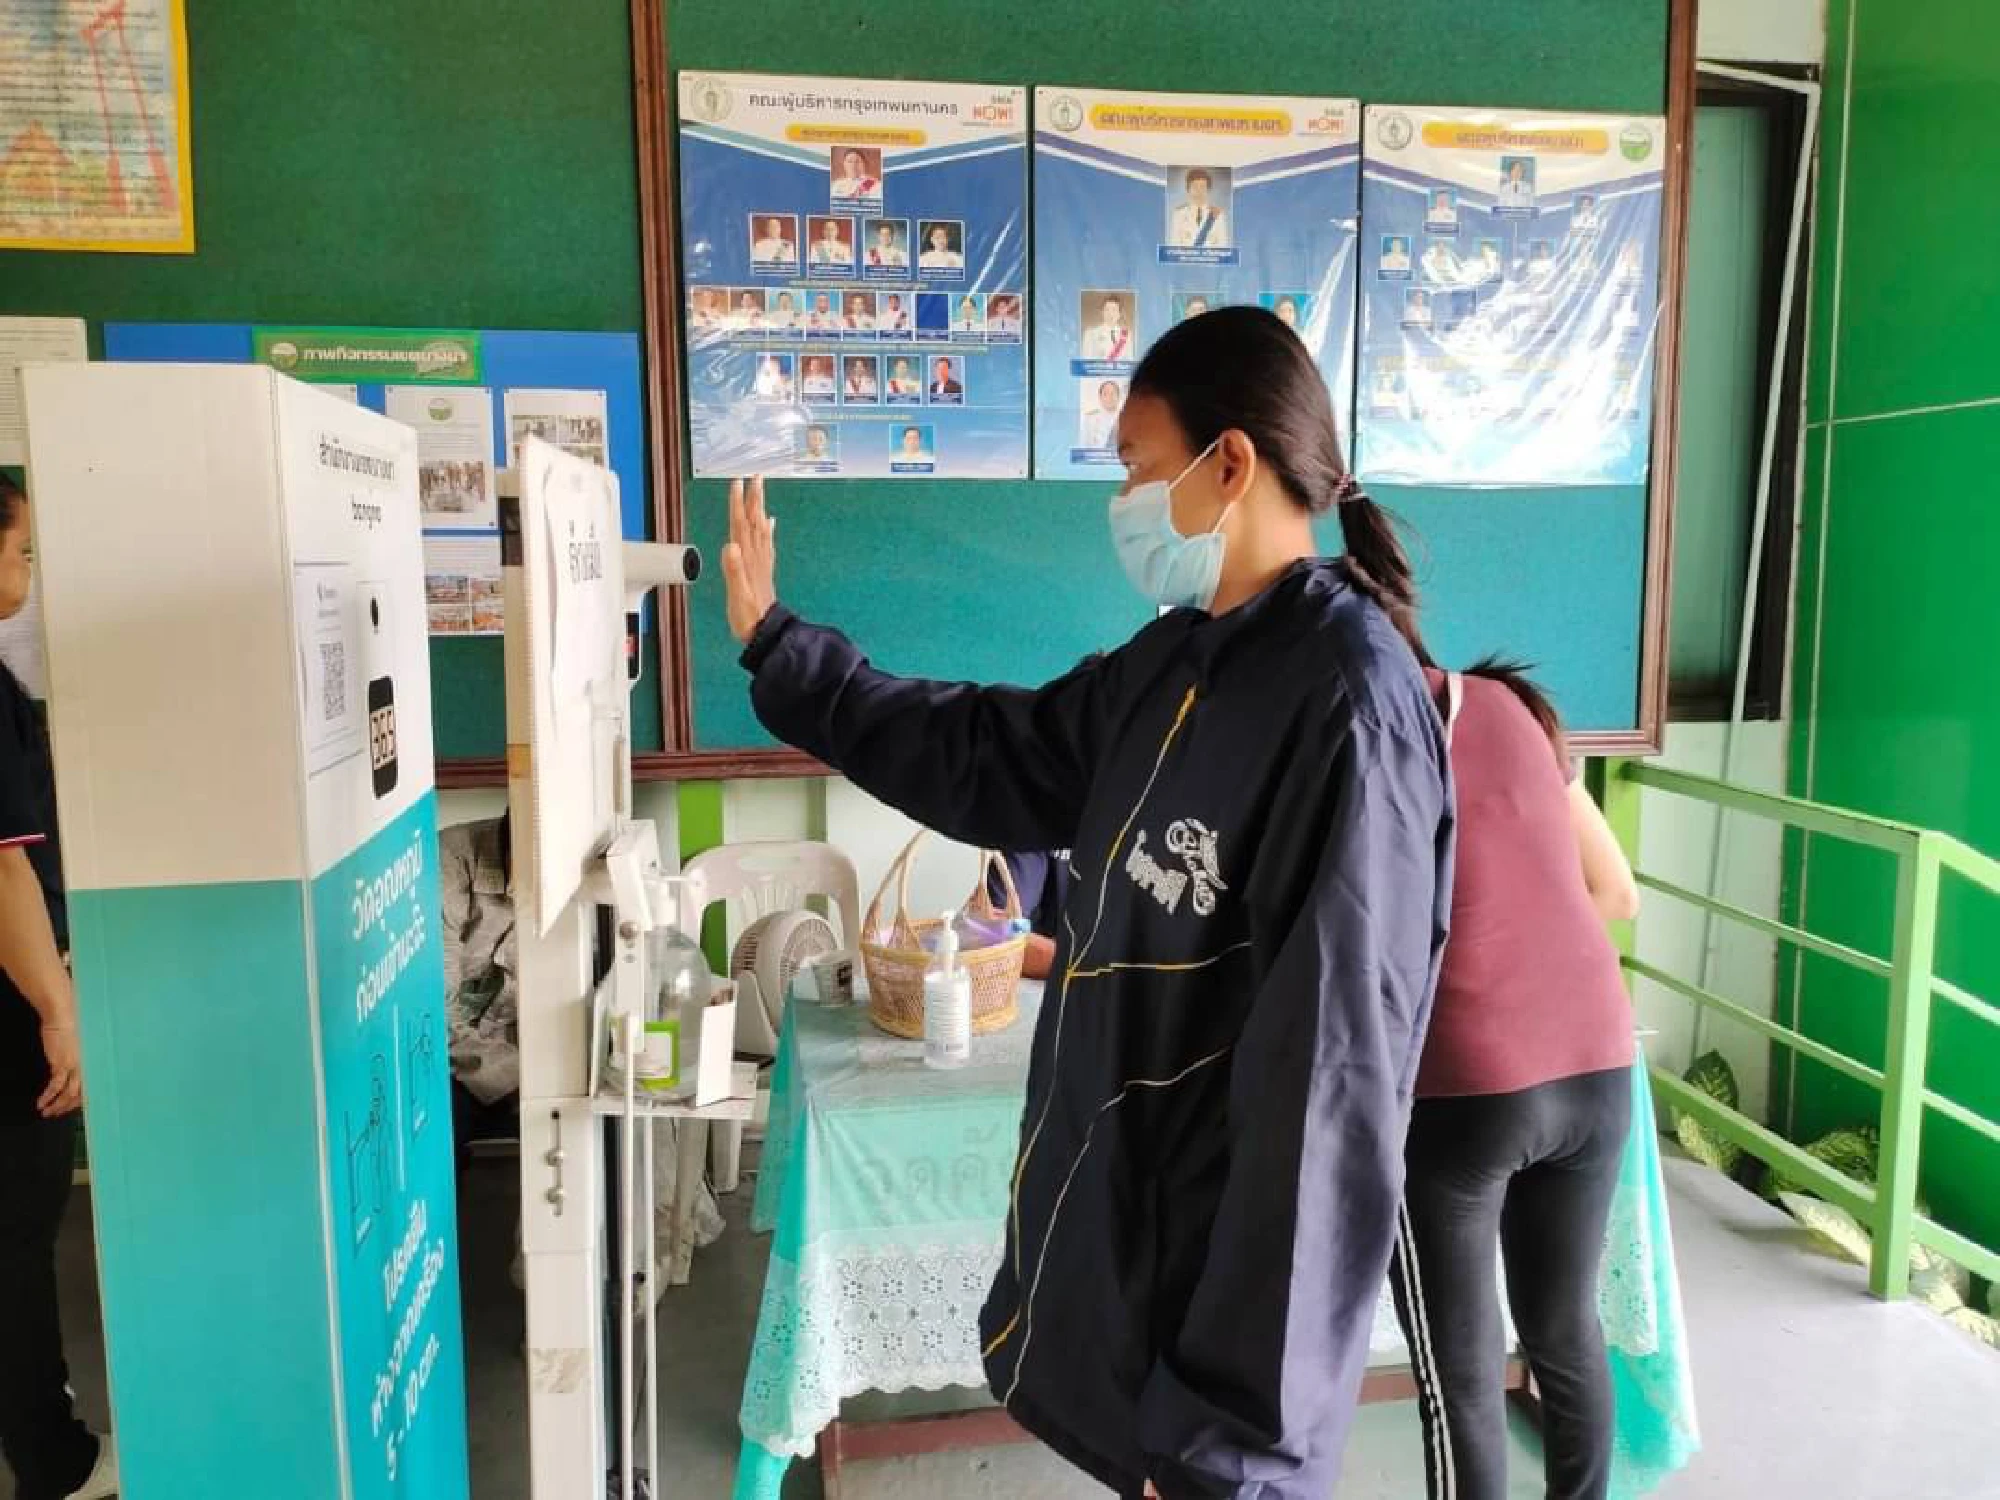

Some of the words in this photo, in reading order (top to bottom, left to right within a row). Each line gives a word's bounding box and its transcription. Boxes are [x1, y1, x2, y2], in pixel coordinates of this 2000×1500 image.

[748, 91, 958, 117] คณะผู้บริหารกรุงเทพมหานคร
[351, 828, 424, 940] วัดอุณหภูมิ
